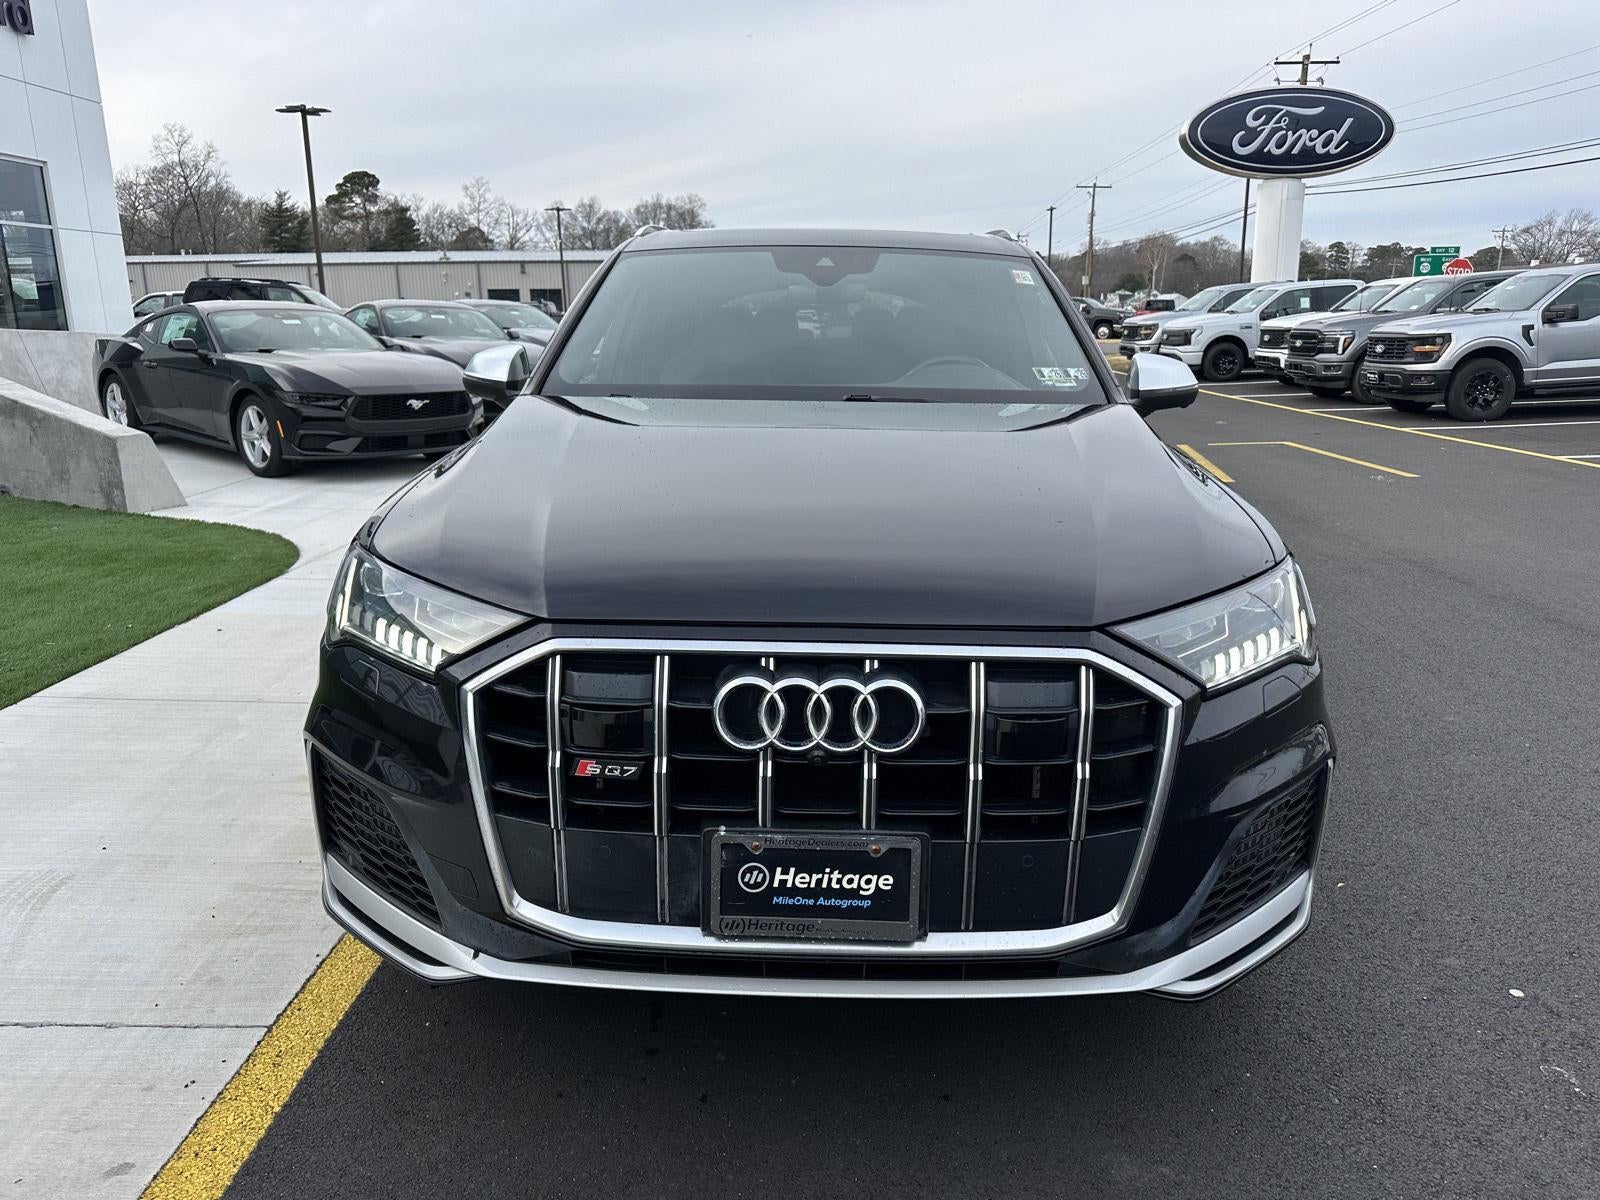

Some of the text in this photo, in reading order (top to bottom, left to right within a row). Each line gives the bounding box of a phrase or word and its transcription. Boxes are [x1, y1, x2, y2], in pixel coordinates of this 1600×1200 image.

[1232, 104, 1353, 155] Ford
[764, 837, 869, 848] HeritageDealers.com
[773, 866, 894, 895] Heritage
[772, 896, 872, 908] MileOne Autogroup
[748, 919, 815, 935] Heritage
